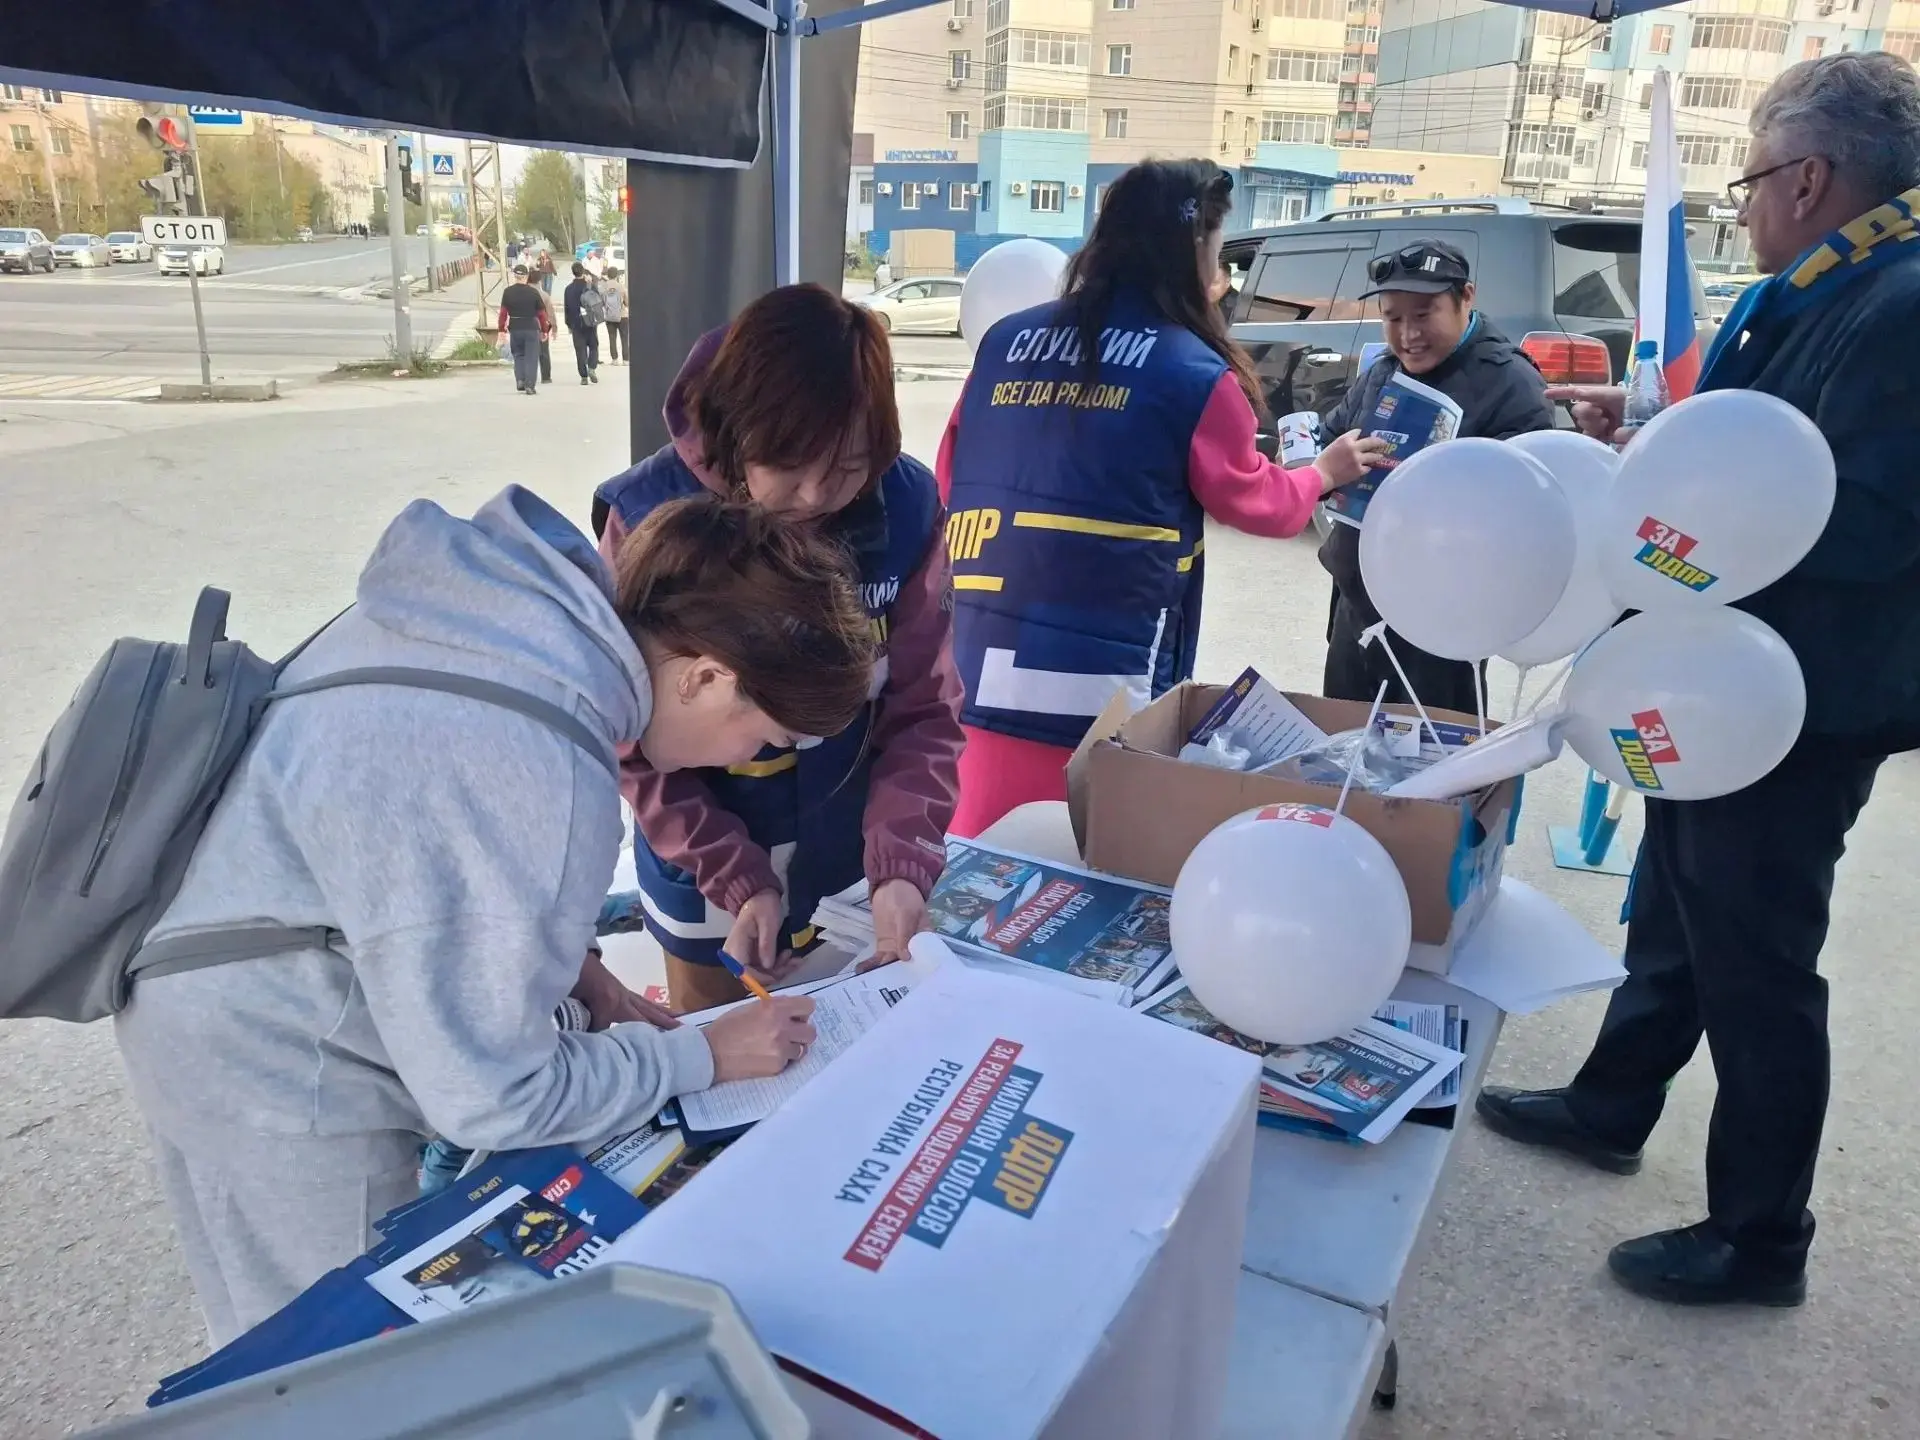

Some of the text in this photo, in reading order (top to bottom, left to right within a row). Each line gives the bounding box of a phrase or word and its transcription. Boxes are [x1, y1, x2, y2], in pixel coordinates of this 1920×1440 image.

[885, 149, 959, 161] ИНГОССТРАХ
[1338, 171, 1415, 185] ИНГОССТРАХ
[154, 223, 215, 240] СТОП
[1006, 326, 1158, 368] СЛУЦИЙ
[991, 381, 1131, 411] ВСЕГДА РЯДОМ!
[946, 508, 1001, 562] ДПР
[1648, 524, 1681, 553] ЗА
[1642, 548, 1711, 585] ЛДПР
[1638, 723, 1673, 754] ЗА
[1616, 735, 1660, 788] ЛДПР
[1277, 806, 1316, 822] ЗА
[1033, 882, 1076, 908] СПАСИ
[1055, 892, 1095, 920] СДЕЛАЙ
[991, 906, 1048, 944] РОССИЮ!
[1030, 917, 1067, 944] ВЫБОР
[621, 1128, 655, 1154] ОНЕРЫ
[834, 1058, 964, 1204] РЕСПУБЛИКА САХА
[855, 1044, 1015, 1261] ЗА РЕАЛЬНУЮ ПОДДЕРЖКУ СЕМЕЙ
[915, 1074, 1035, 1235] МИЛЛИОН ГОЛОСОВ
[991, 1120, 1065, 1212] ЛДПР
[542, 1177, 572, 1202] СПА
[420, 1251, 461, 1281] ЛДПР
